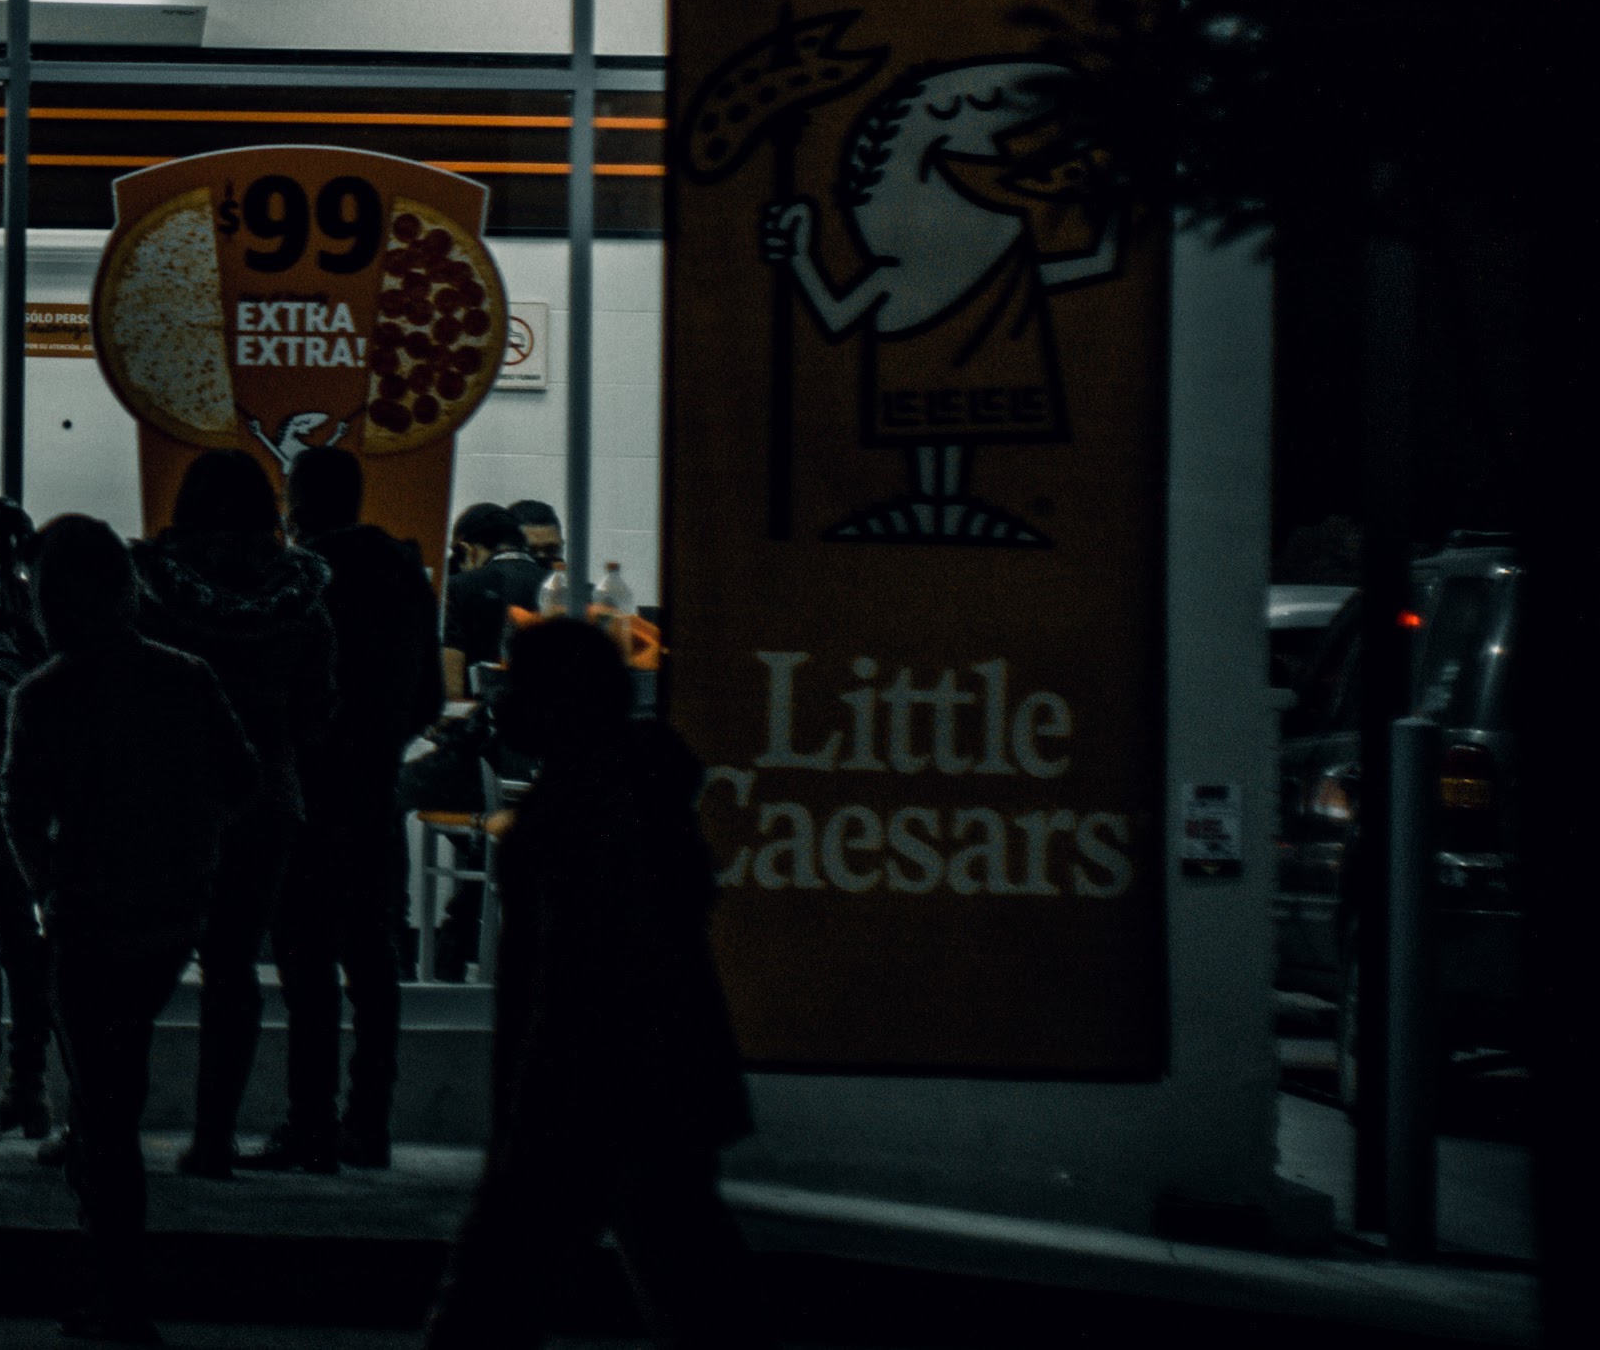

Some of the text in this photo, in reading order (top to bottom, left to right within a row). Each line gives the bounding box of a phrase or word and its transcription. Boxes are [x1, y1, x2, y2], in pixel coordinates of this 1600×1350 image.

[218, 175, 382, 273] $99
[235, 300, 355, 335] EXTRA
[235, 335, 368, 368] EXTRA!
[754, 650, 1075, 779] Little
[691, 765, 1136, 899] Caesars
